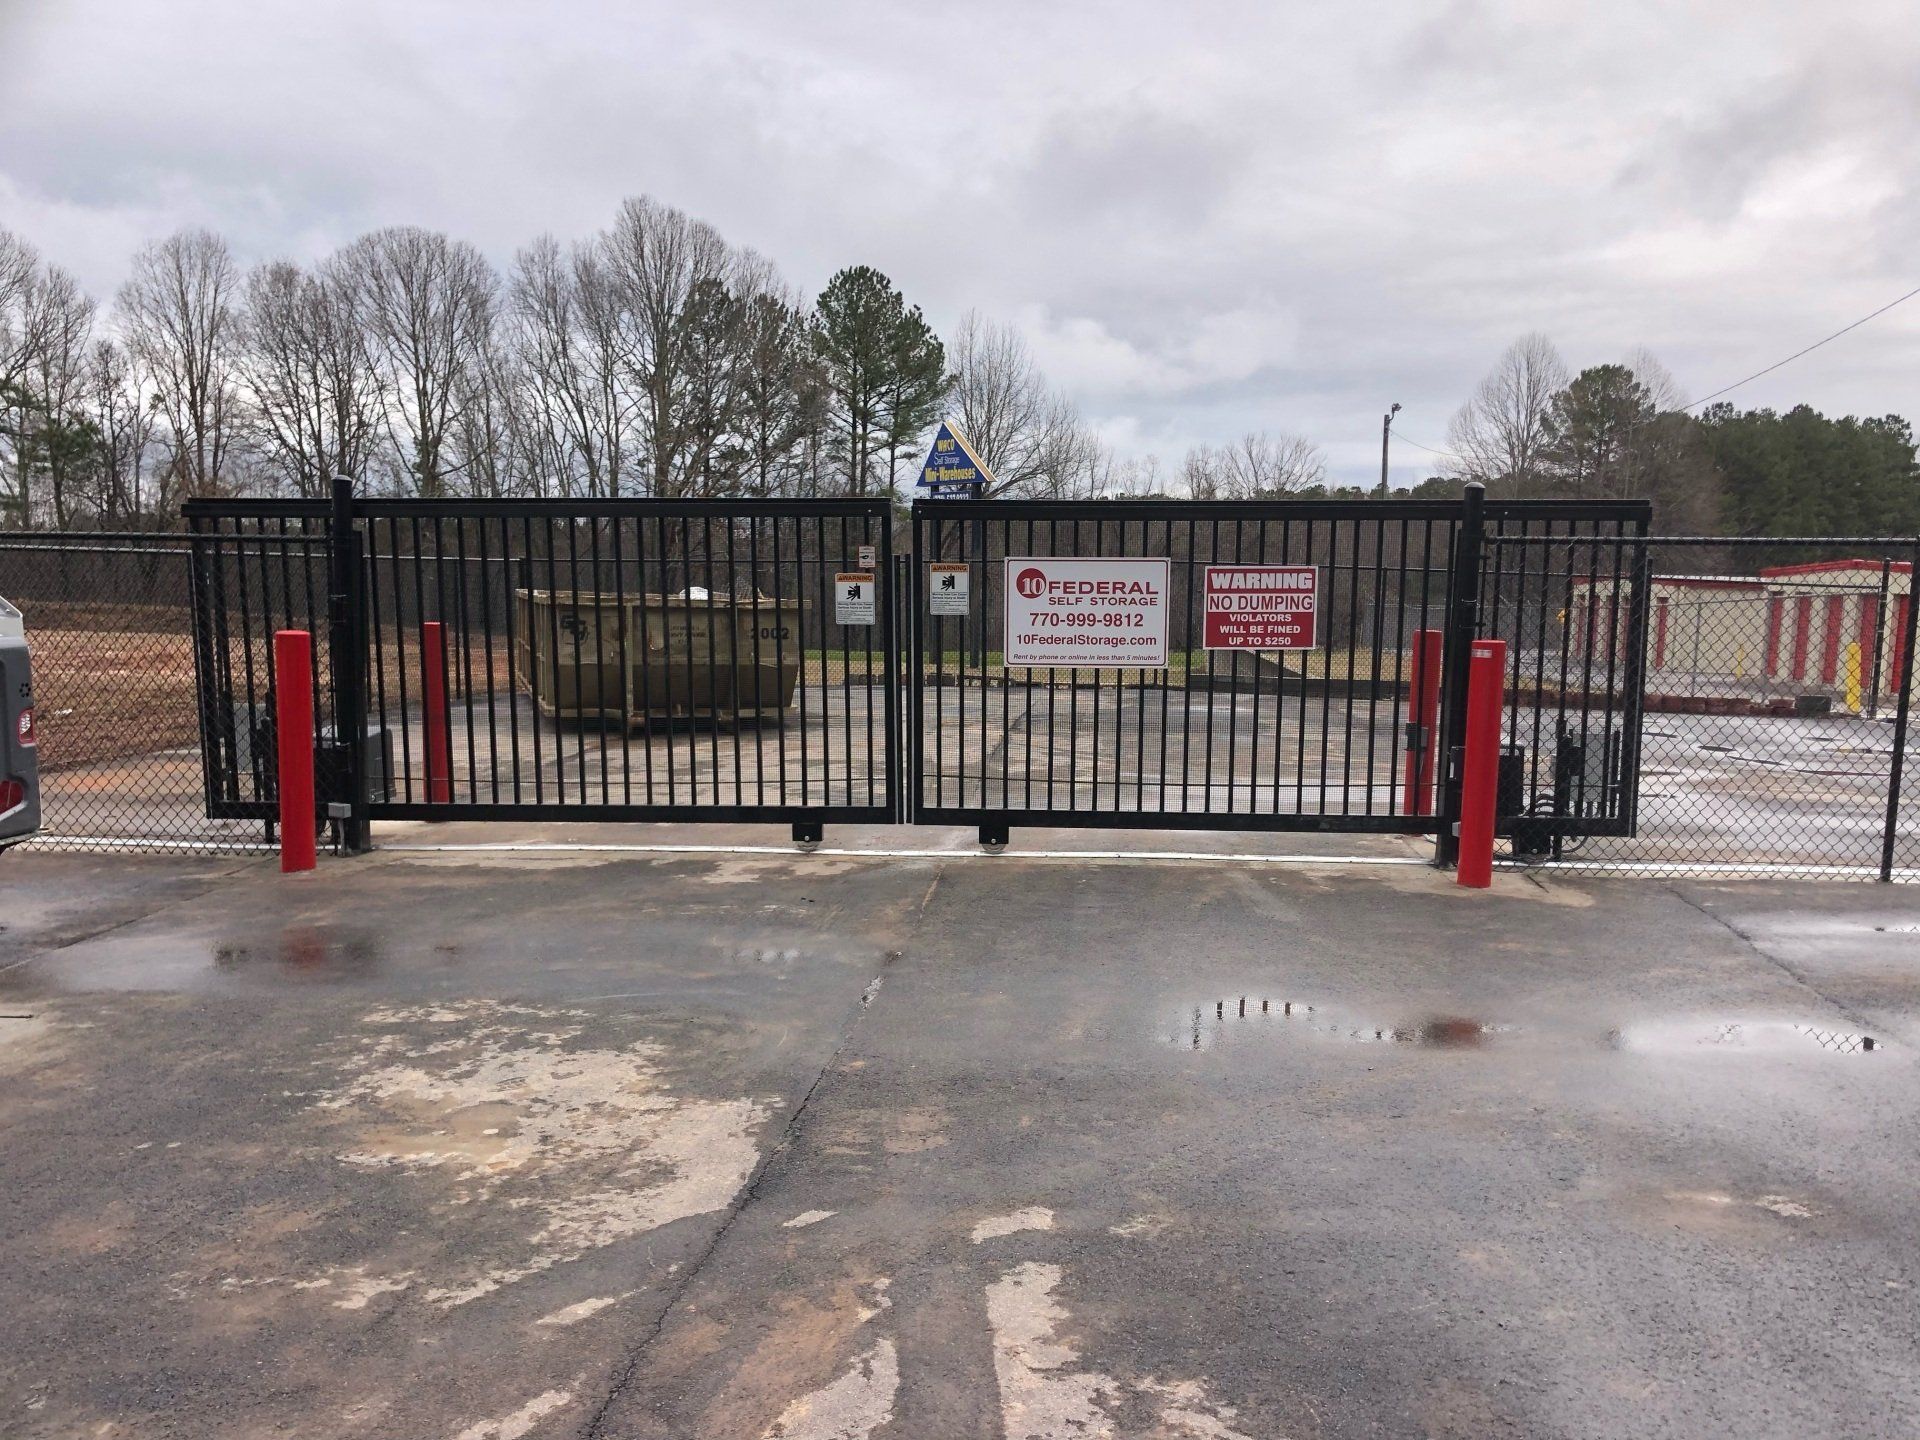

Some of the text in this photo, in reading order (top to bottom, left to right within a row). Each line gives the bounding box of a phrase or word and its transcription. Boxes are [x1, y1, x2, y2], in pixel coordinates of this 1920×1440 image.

[925, 466, 976, 482] Mini-Warehouses
[1022, 577, 1159, 595] 10 FEDERAL
[1211, 573, 1313, 590] WARNING
[1048, 597, 1158, 606] SELF STORAGE
[1209, 595, 1313, 611] NO DUMPING
[1029, 612, 1144, 627] 770-999-9812
[1229, 614, 1292, 622] VIOLATORS
[1268, 626, 1301, 634] FINED
[1016, 634, 1157, 648] 10FederalStorage.com
[1229, 637, 1291, 645] UP TO $250
[1029, 653, 1038, 661] by
